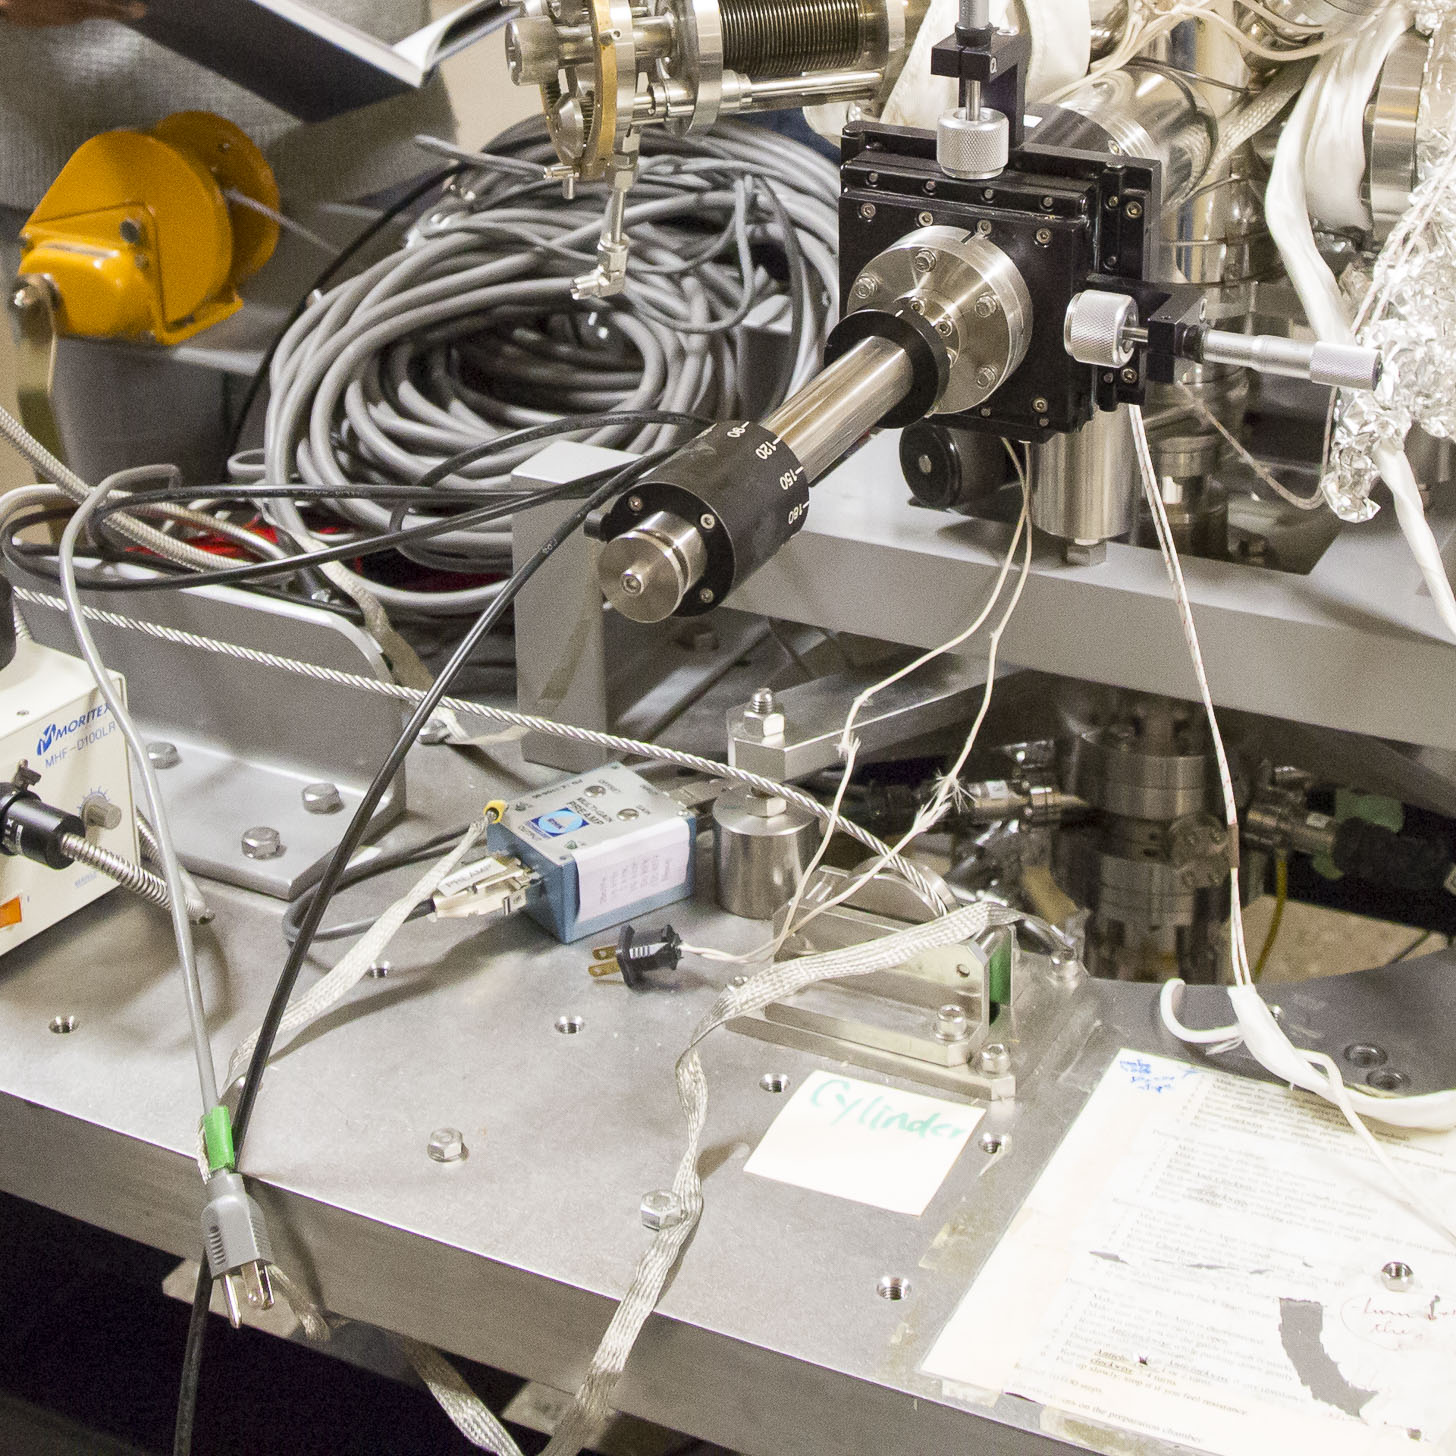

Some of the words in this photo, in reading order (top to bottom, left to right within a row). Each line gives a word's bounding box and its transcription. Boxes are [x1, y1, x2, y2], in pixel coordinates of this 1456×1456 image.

[755, 441, 777, 460] 120
[779, 469, 798, 491] 150
[788, 503, 803, 525] 180
[810, 1078, 968, 1139] Cylinder
